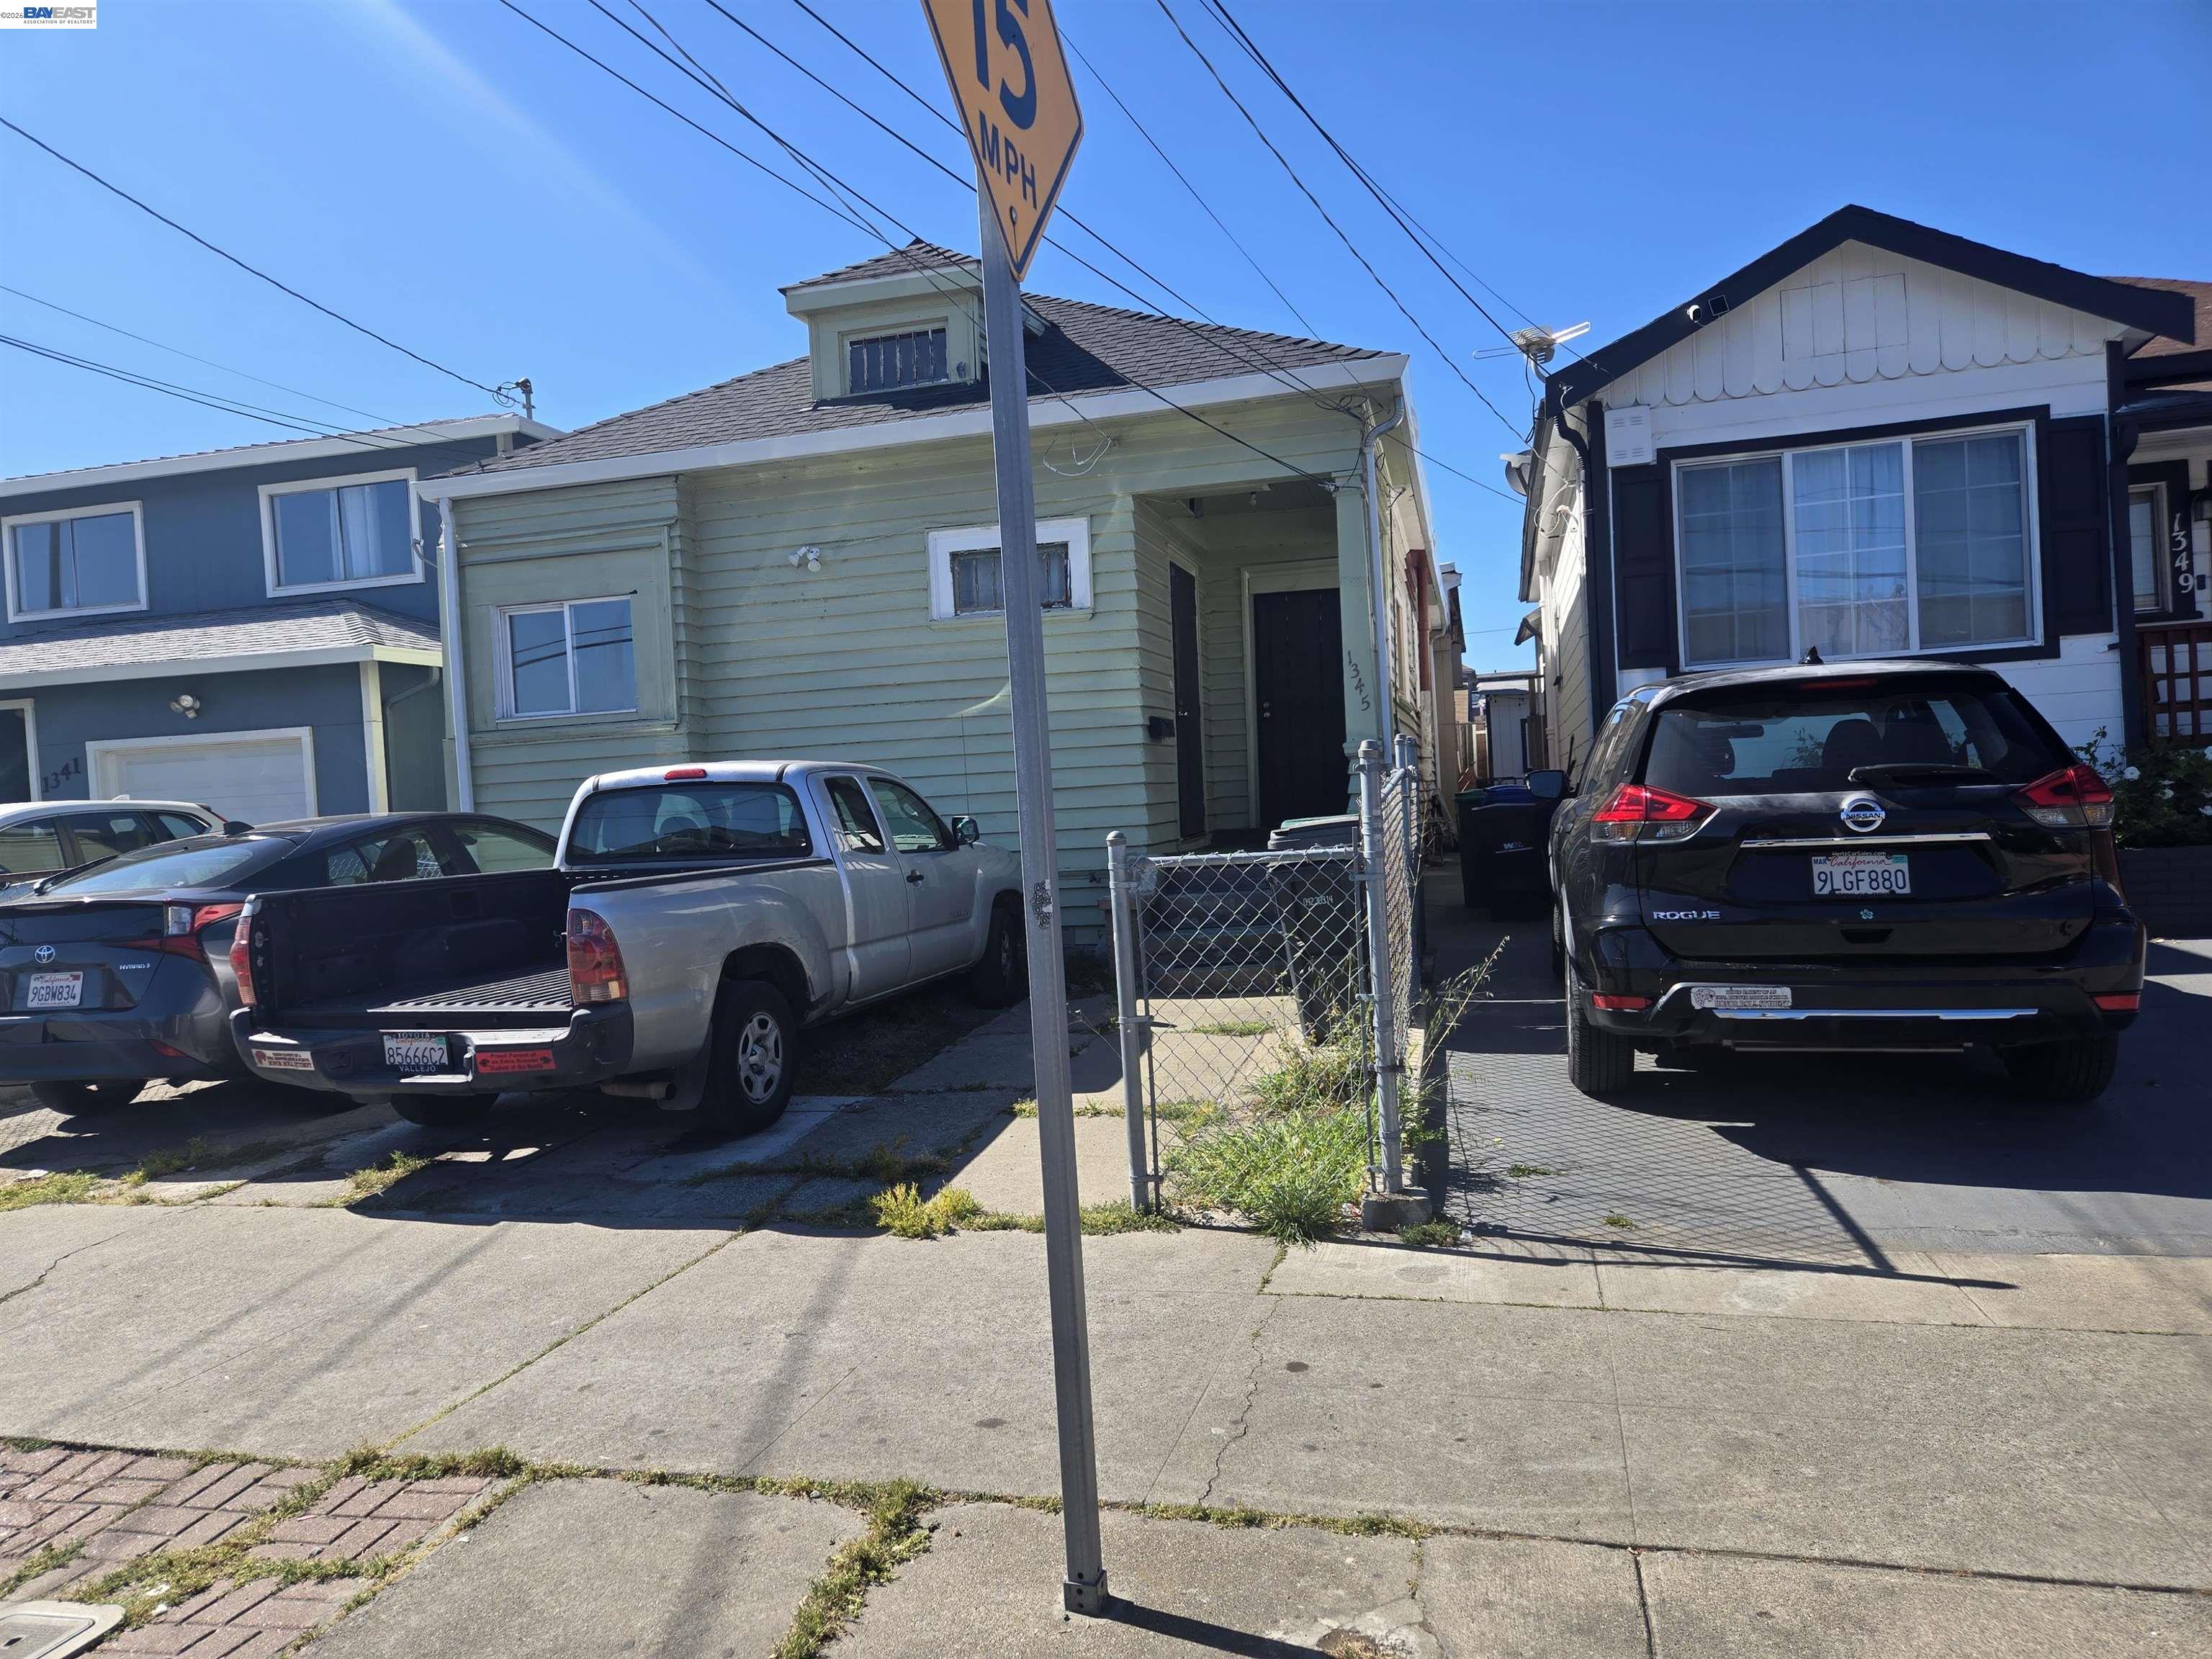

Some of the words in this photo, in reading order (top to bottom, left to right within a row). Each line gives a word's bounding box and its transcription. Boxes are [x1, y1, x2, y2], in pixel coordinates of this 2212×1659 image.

[972, 0, 1037, 130] 15
[979, 109, 1037, 210] MPH
[2172, 513, 2194, 593] 1349
[1348, 650, 1370, 711] 1345
[42, 757, 81, 793] 1341
[1830, 855, 1892, 869] California
[1817, 869, 1907, 892] 9LGF880
[1653, 911, 1721, 920] ROGUE
[31, 984, 77, 1002] 9GBW834
[387, 1047, 446, 1065] 85666C2
